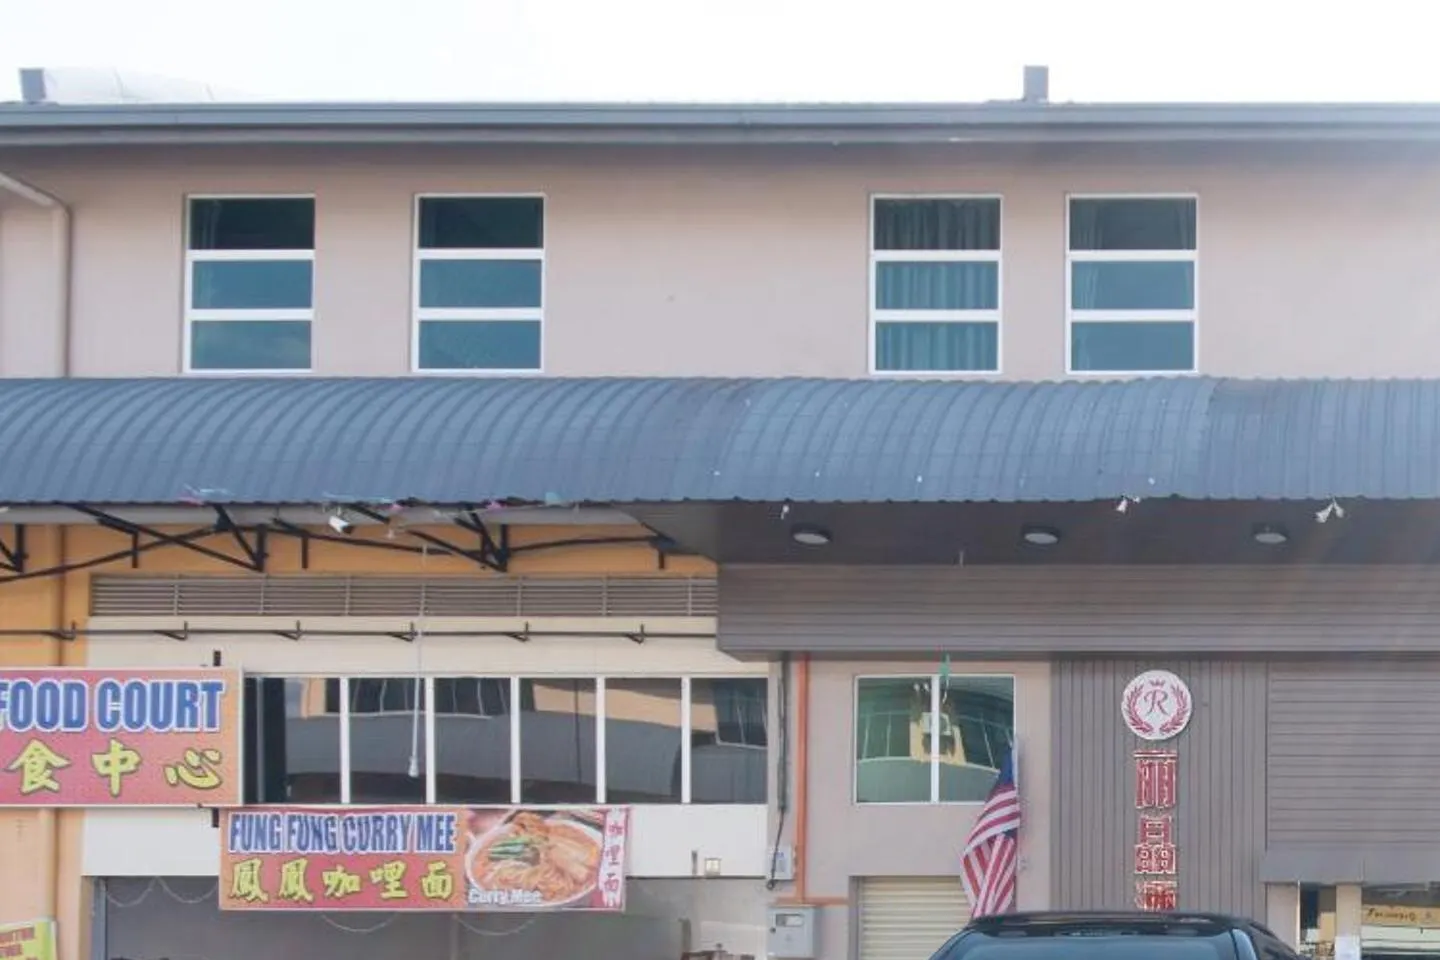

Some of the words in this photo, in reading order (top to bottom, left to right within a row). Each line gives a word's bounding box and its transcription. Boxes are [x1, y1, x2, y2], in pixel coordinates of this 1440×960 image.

[97, 679, 224, 732] COURT
[4, 738, 223, 798] 食中心
[228, 812, 282, 853] FUNG
[341, 813, 411, 853] CURRY
[413, 812, 457, 853] MEE
